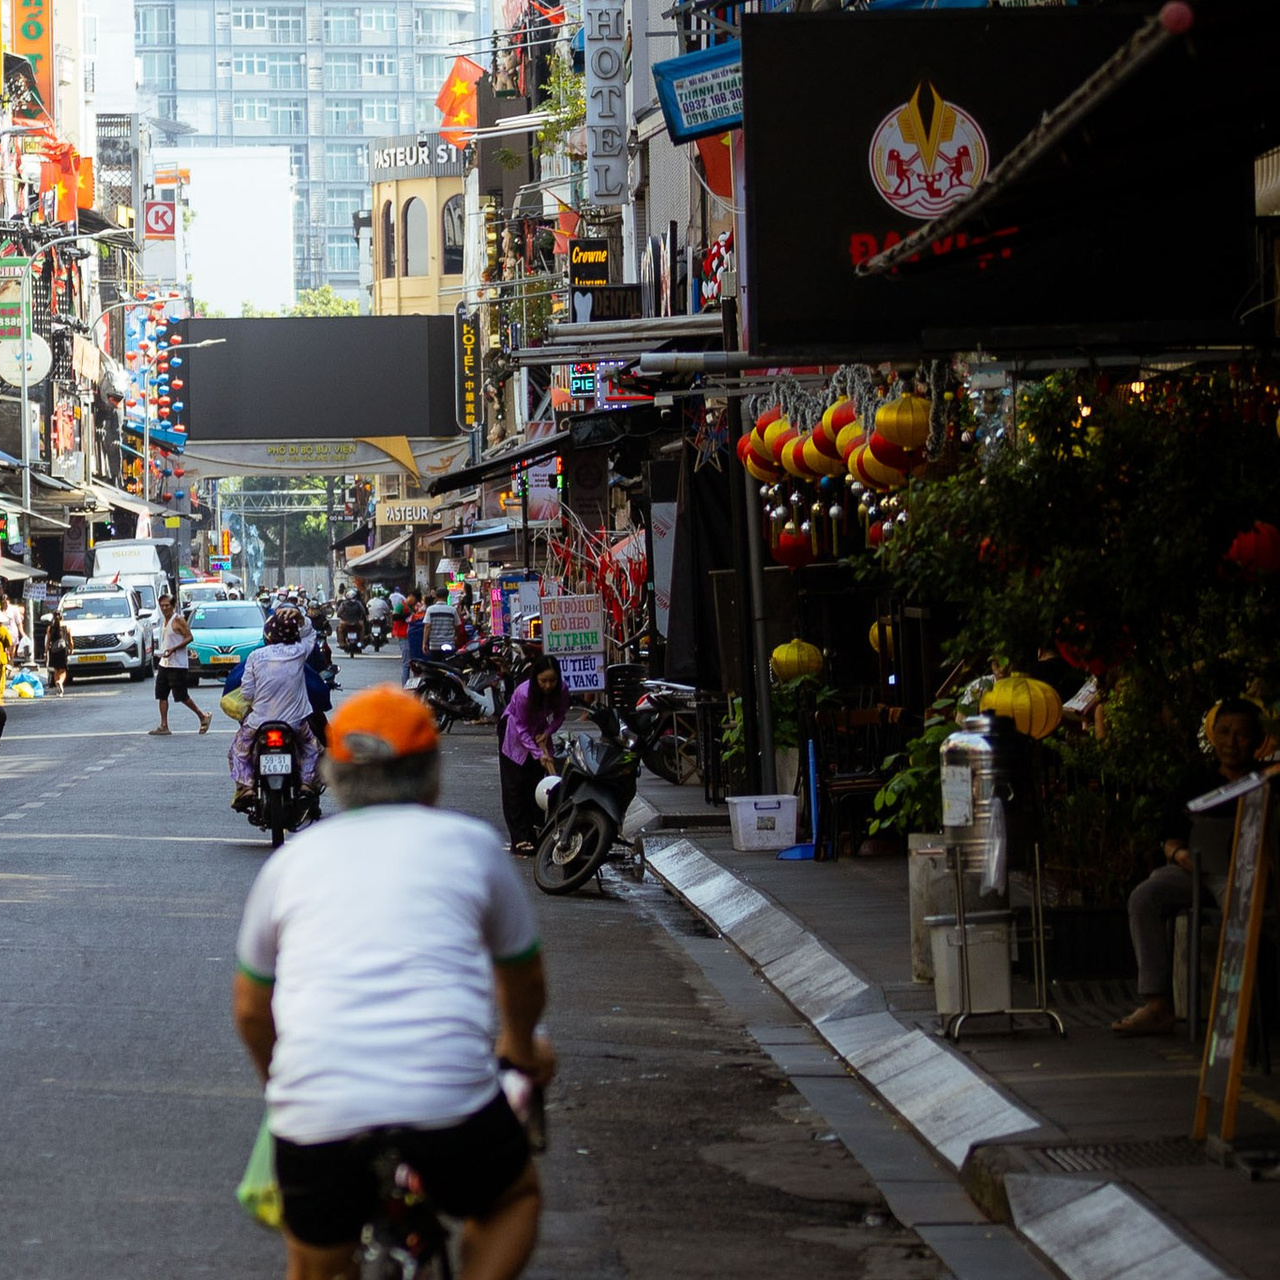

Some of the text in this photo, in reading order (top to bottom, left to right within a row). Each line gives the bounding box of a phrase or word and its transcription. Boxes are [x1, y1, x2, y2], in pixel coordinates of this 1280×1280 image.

[586, 8, 623, 197] HOTEL
[374, 146, 429, 169] PASTEUR
[572, 246, 607, 264] Crowne
[594, 290, 639, 317] DENTAL
[462, 323, 476, 377] HOTEL
[572, 379, 594, 391] PIE
[386, 506, 428, 521] PASTEUR
[569, 617, 590, 630] HEO
[574, 673, 599, 688] VANG
